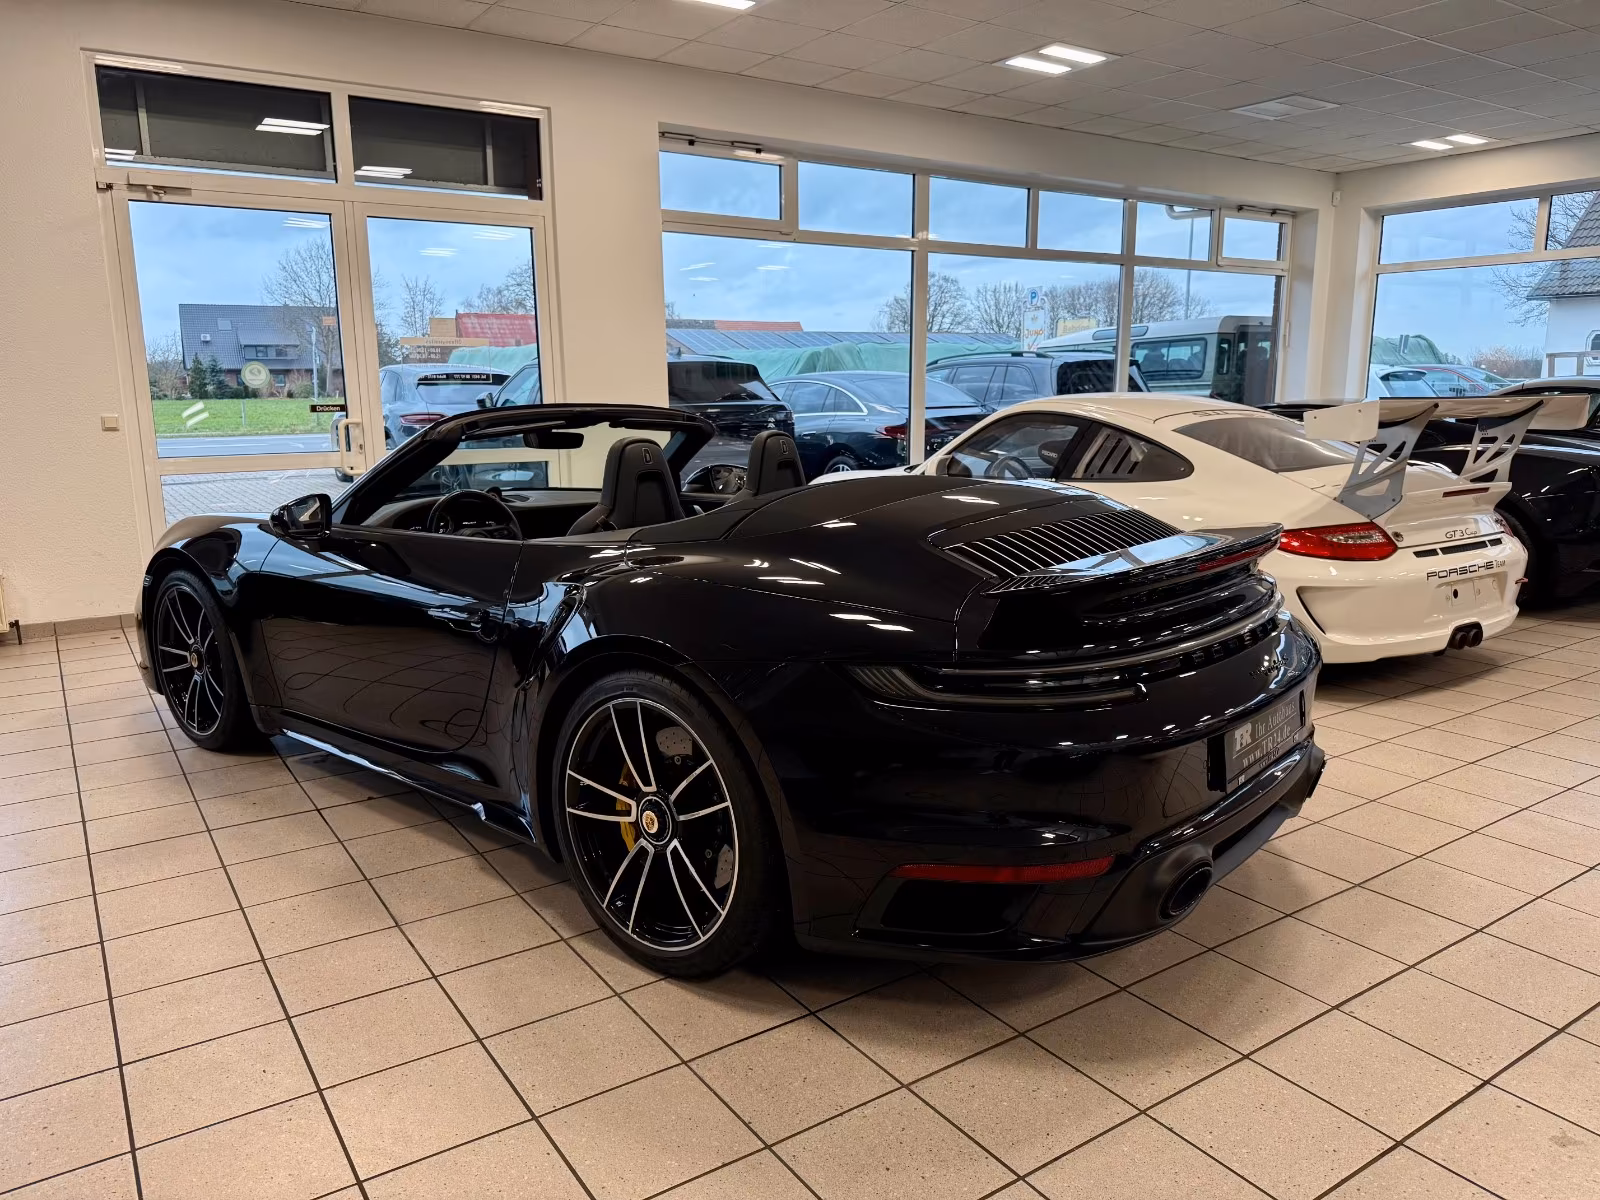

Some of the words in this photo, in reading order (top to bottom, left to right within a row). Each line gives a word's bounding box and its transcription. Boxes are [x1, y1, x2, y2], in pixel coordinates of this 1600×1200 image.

[1426, 561, 1494, 581] PORSCHE
[1255, 721, 1266, 739] Ihr
[1267, 701, 1296, 731] Autohaus
